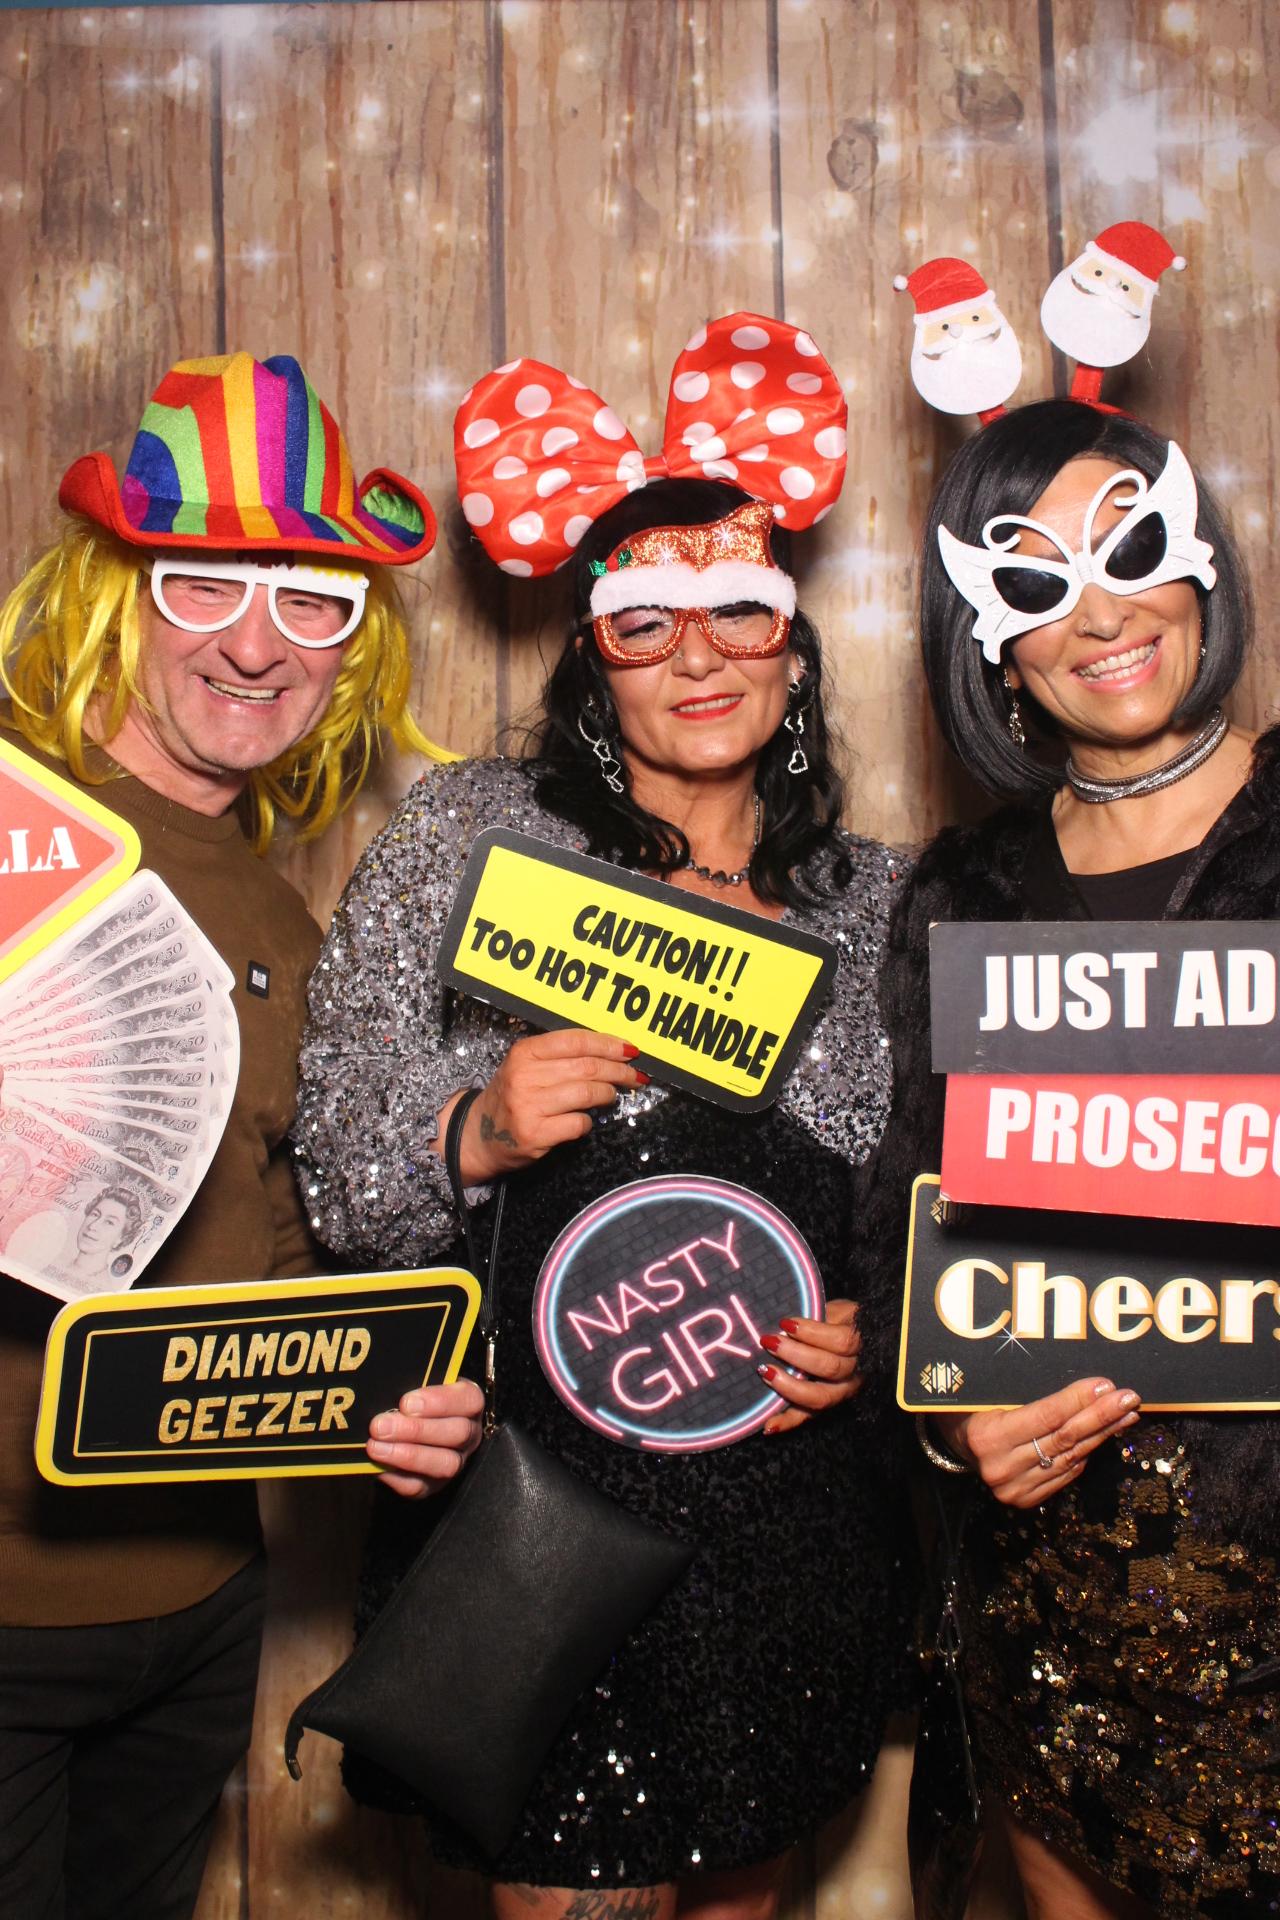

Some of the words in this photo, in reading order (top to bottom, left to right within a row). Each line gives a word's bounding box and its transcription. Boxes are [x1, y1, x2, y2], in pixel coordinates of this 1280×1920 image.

[468, 917, 535, 970] TOO
[535, 946, 609, 1002] HOT
[607, 972, 651, 1021] TO
[648, 992, 780, 1080] HANDLE
[573, 904, 750, 1002] CAUTION!!
[979, 952, 1157, 1032] JUST
[1173, 949, 1277, 1027] AD
[985, 1087, 1280, 1178] PROSEC
[567, 1221, 740, 1350] NASTY
[162, 1328, 371, 1382] DIAMOND
[158, 1387, 355, 1444] GEEZER
